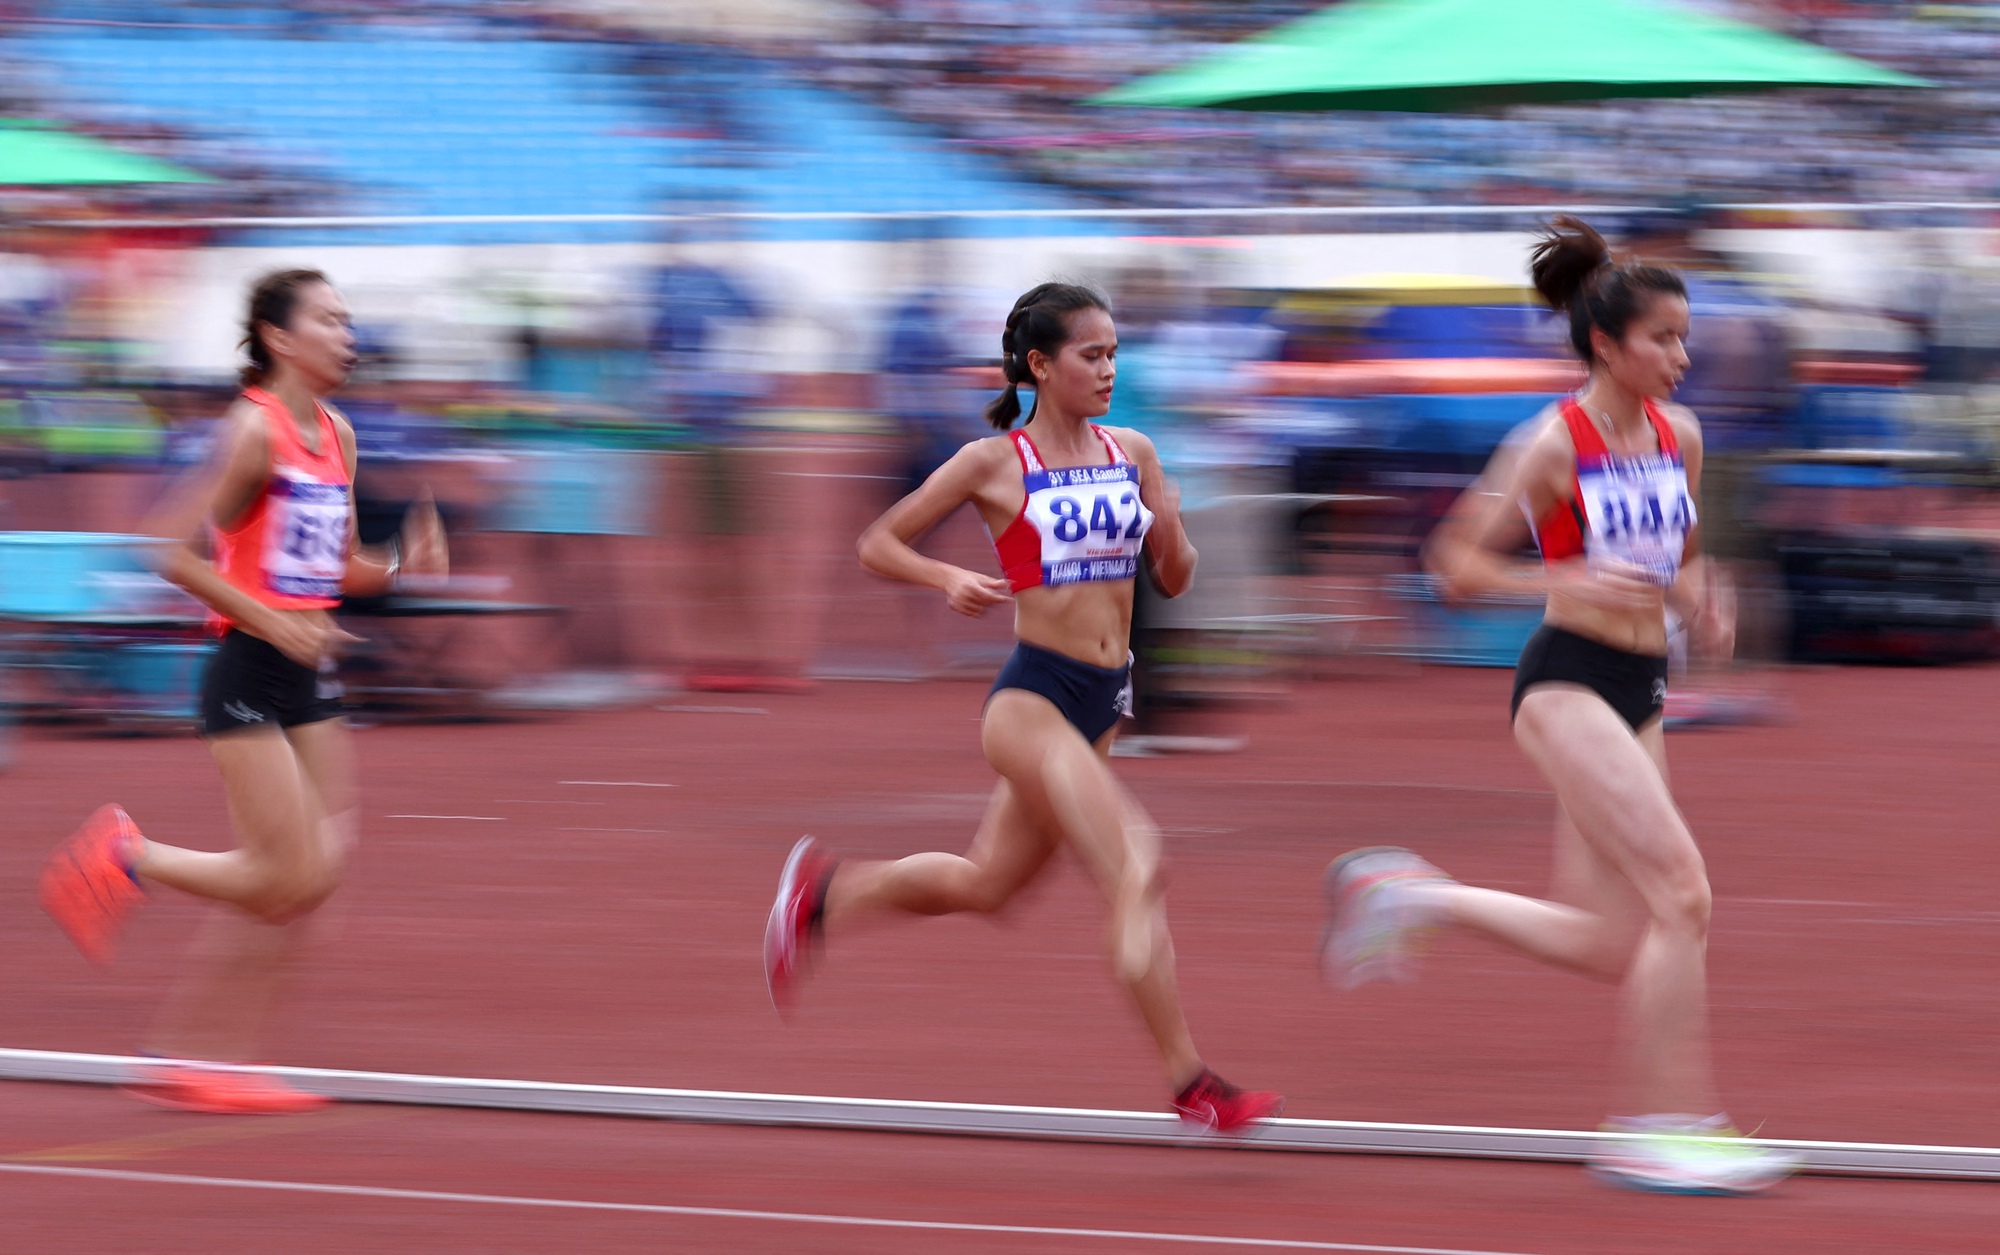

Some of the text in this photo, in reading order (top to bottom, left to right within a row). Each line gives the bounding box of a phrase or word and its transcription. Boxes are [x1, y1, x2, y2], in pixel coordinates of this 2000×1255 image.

[1069, 468, 1092, 484] SEA
[1092, 466, 1129, 481] Games
[1049, 491, 1144, 542] 842
[1089, 559, 1127, 580] VIETNAM
